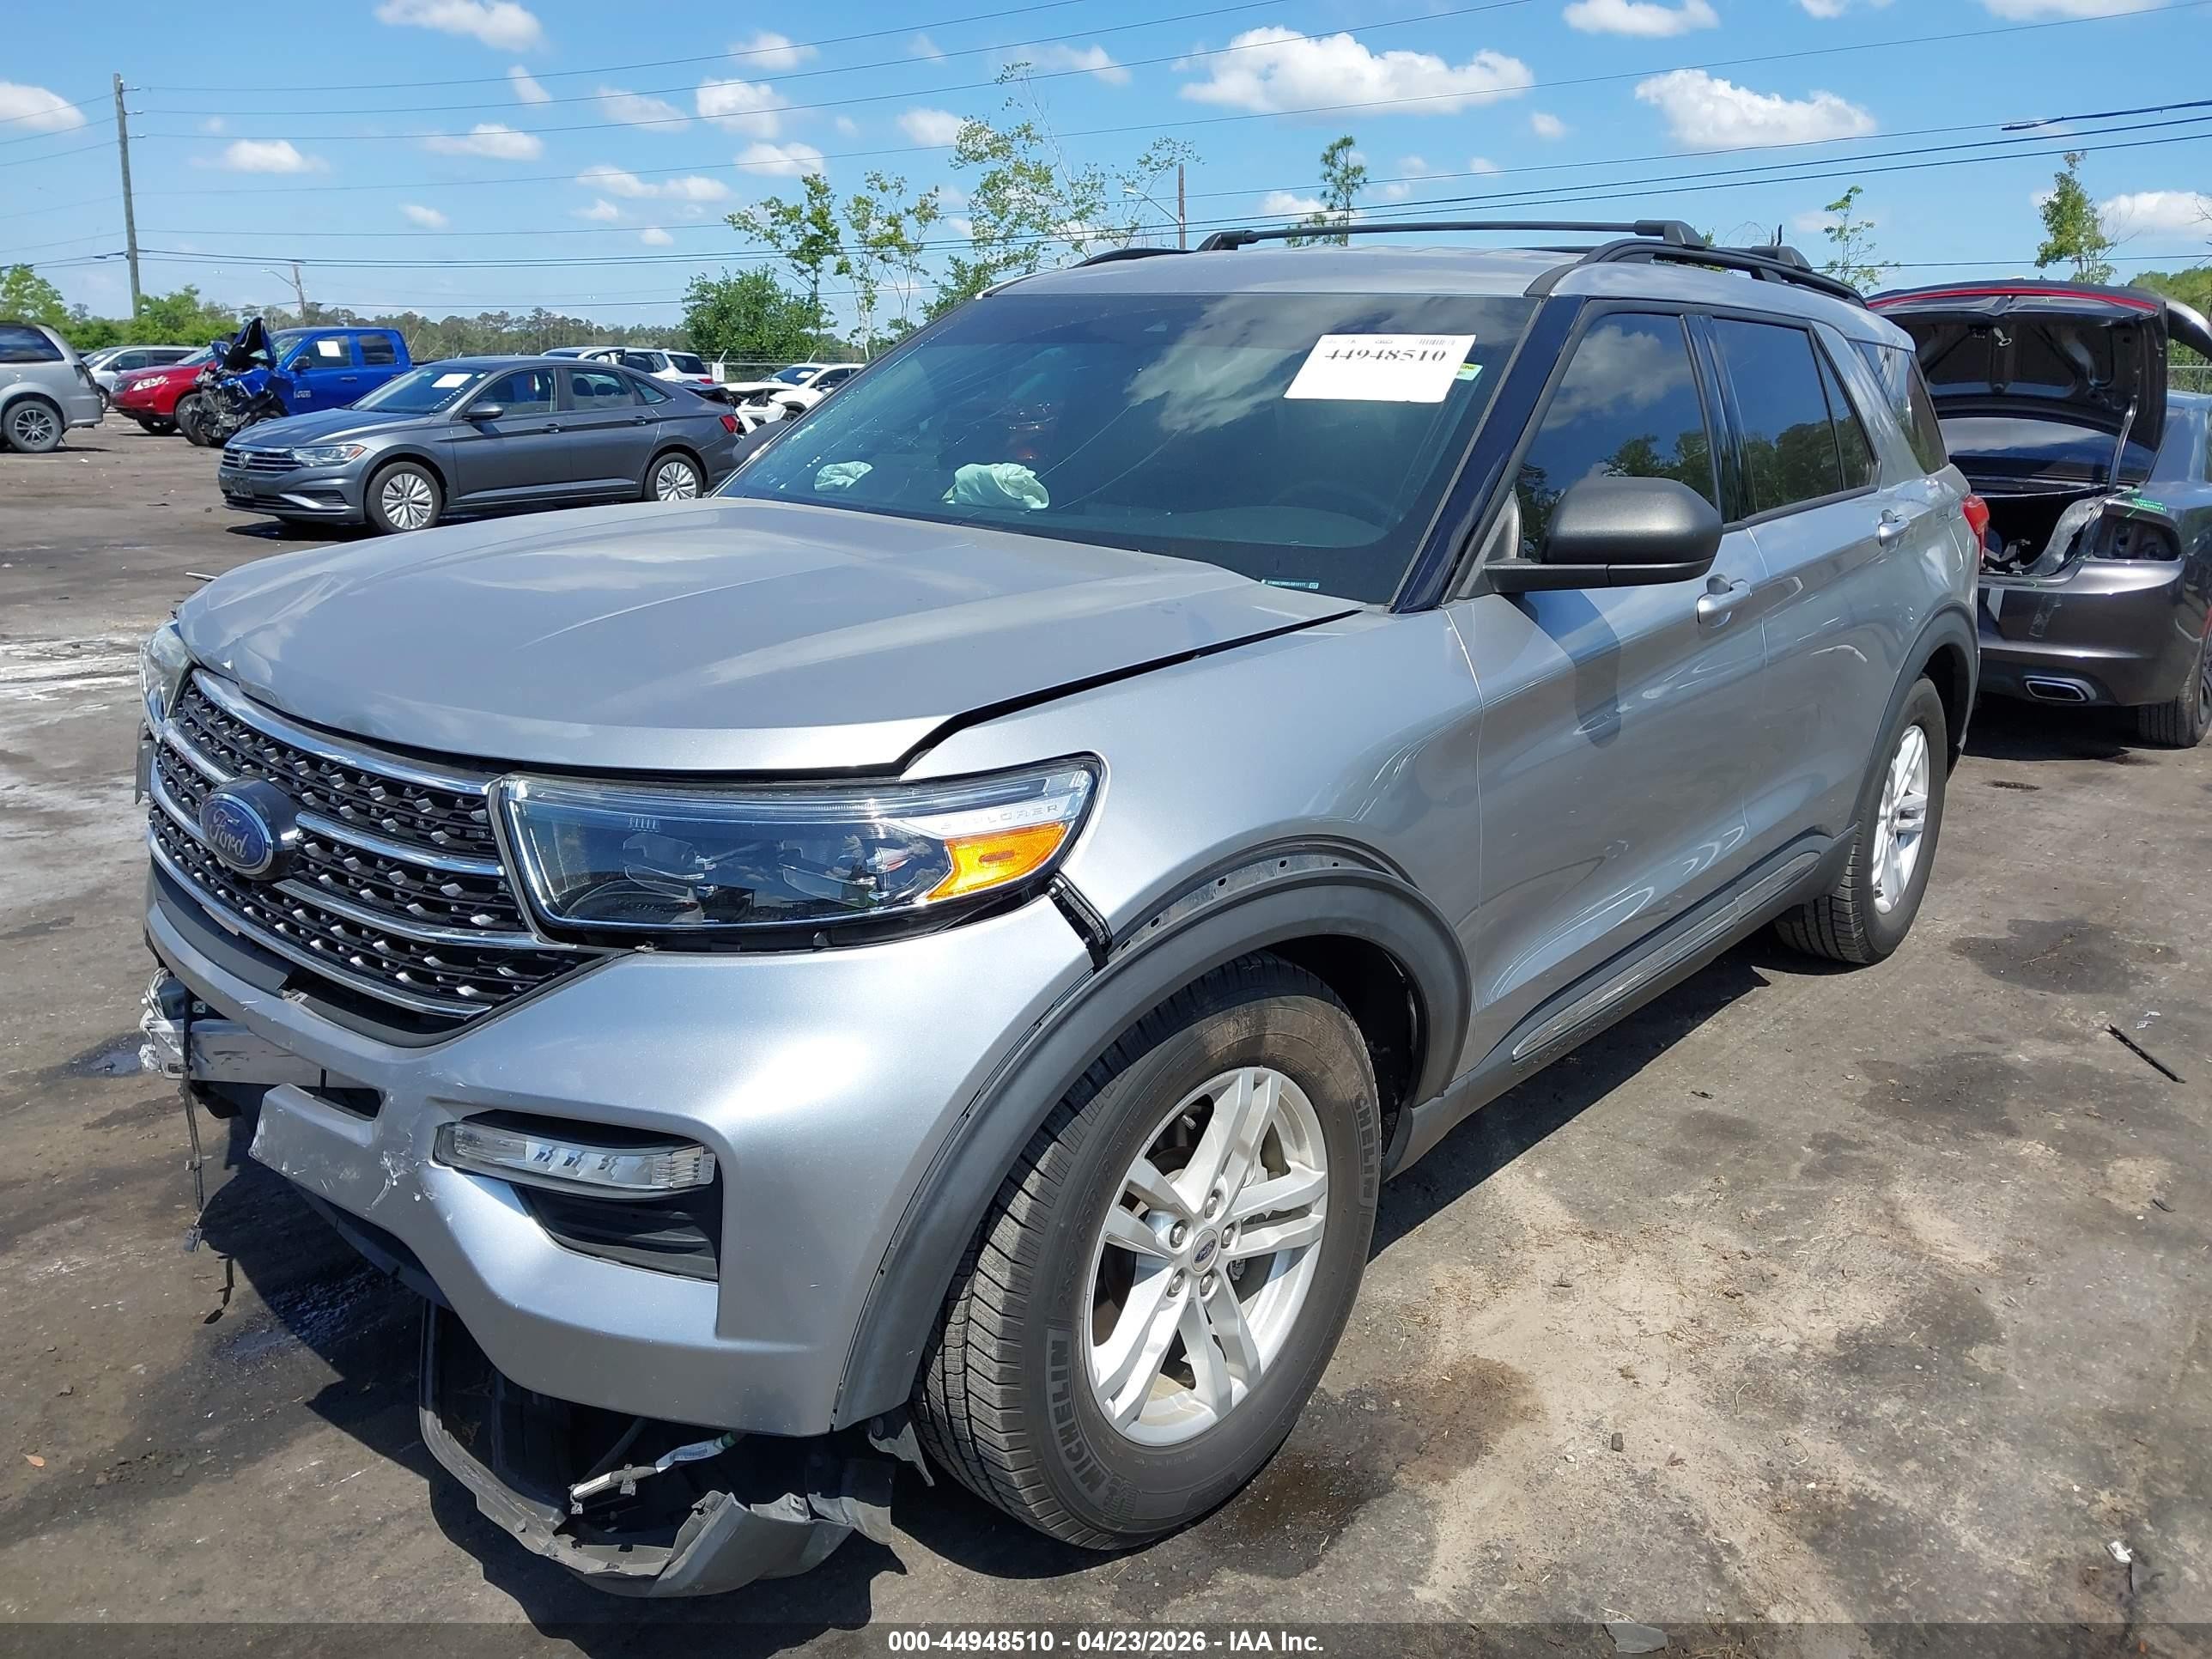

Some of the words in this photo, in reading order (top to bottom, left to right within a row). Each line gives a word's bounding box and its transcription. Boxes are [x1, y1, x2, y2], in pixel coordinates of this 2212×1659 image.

[1325, 349, 1446, 362] 44948510
[210, 808, 249, 858] Ford
[941, 804, 1059, 830] LORER
[1050, 1340, 1107, 1494] MICHELIN
